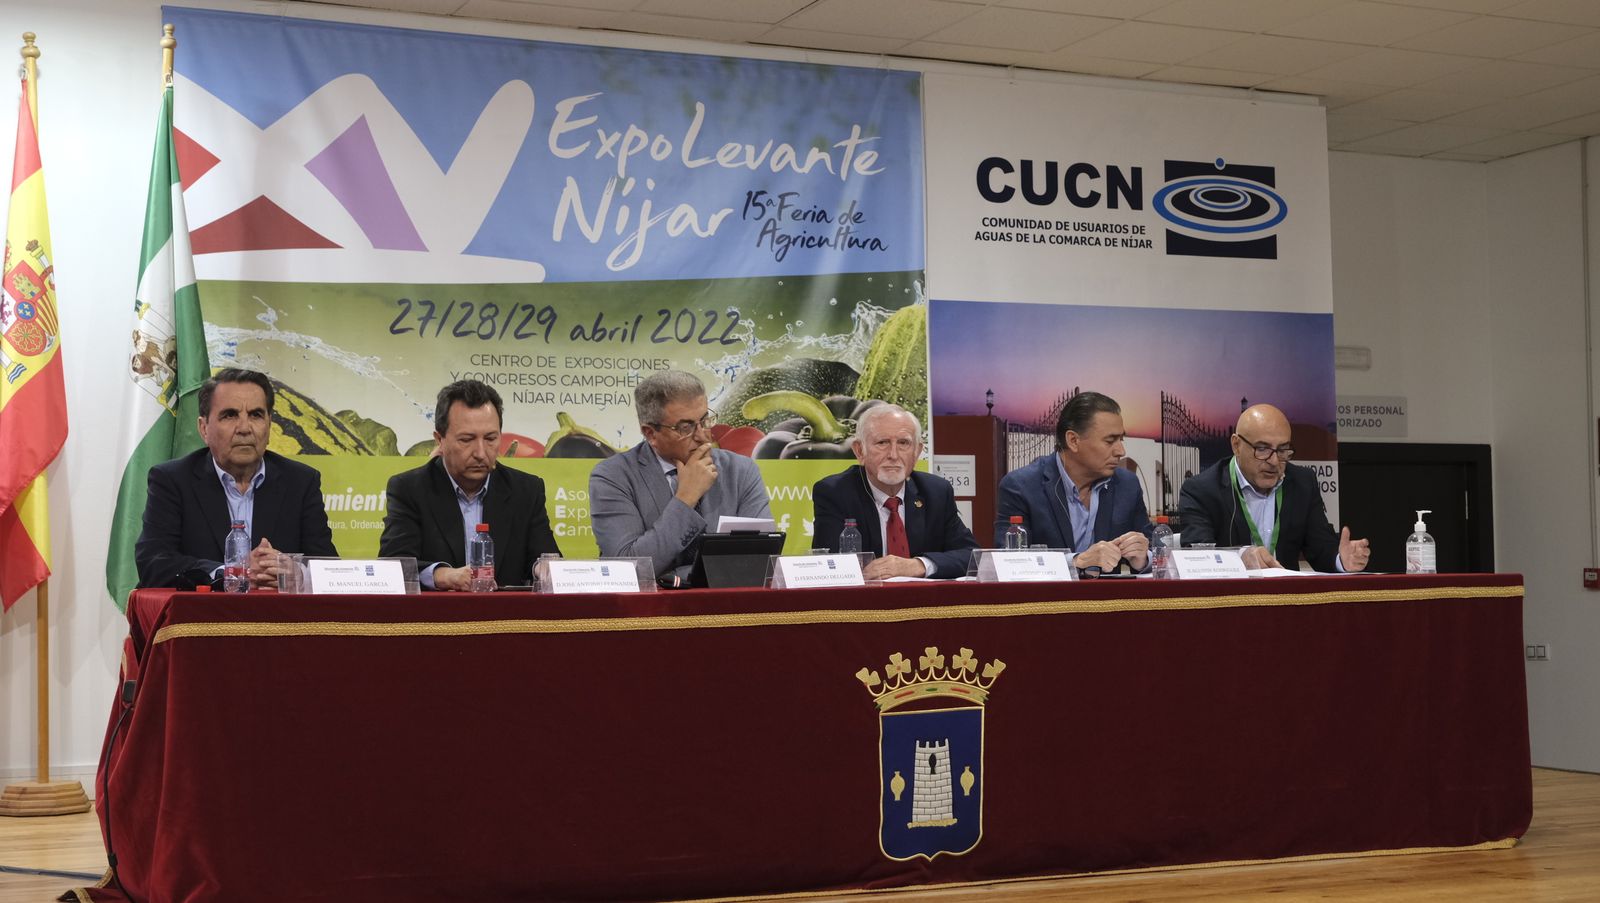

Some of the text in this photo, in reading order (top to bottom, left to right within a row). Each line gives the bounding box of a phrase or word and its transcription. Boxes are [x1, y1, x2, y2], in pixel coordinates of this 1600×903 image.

[976, 156, 1144, 211] CUCN
[776, 191, 834, 225] Feria
[838, 200, 866, 225] de
[552, 175, 734, 272] Níjar
[981, 217, 1146, 236] COMUNIDAD DE USUARIOS DE
[756, 217, 888, 262] Agricultura
[974, 230, 1153, 250] AGUAS DE LA COMARCA DE NÍJAR
[389, 298, 742, 346] 27/28/29 abril 2022
[470, 353, 671, 371] CENTRO DE EXPOSICIONES
[450, 371, 460, 383] Y
[513, 388, 632, 407] NÍJAR (ALMERÍA)
[1336, 405, 1405, 416] OS PERSONAL
[1337, 418, 1383, 428] ORIZADO
[322, 486, 387, 512] mient
[555, 487, 590, 501] Aso
